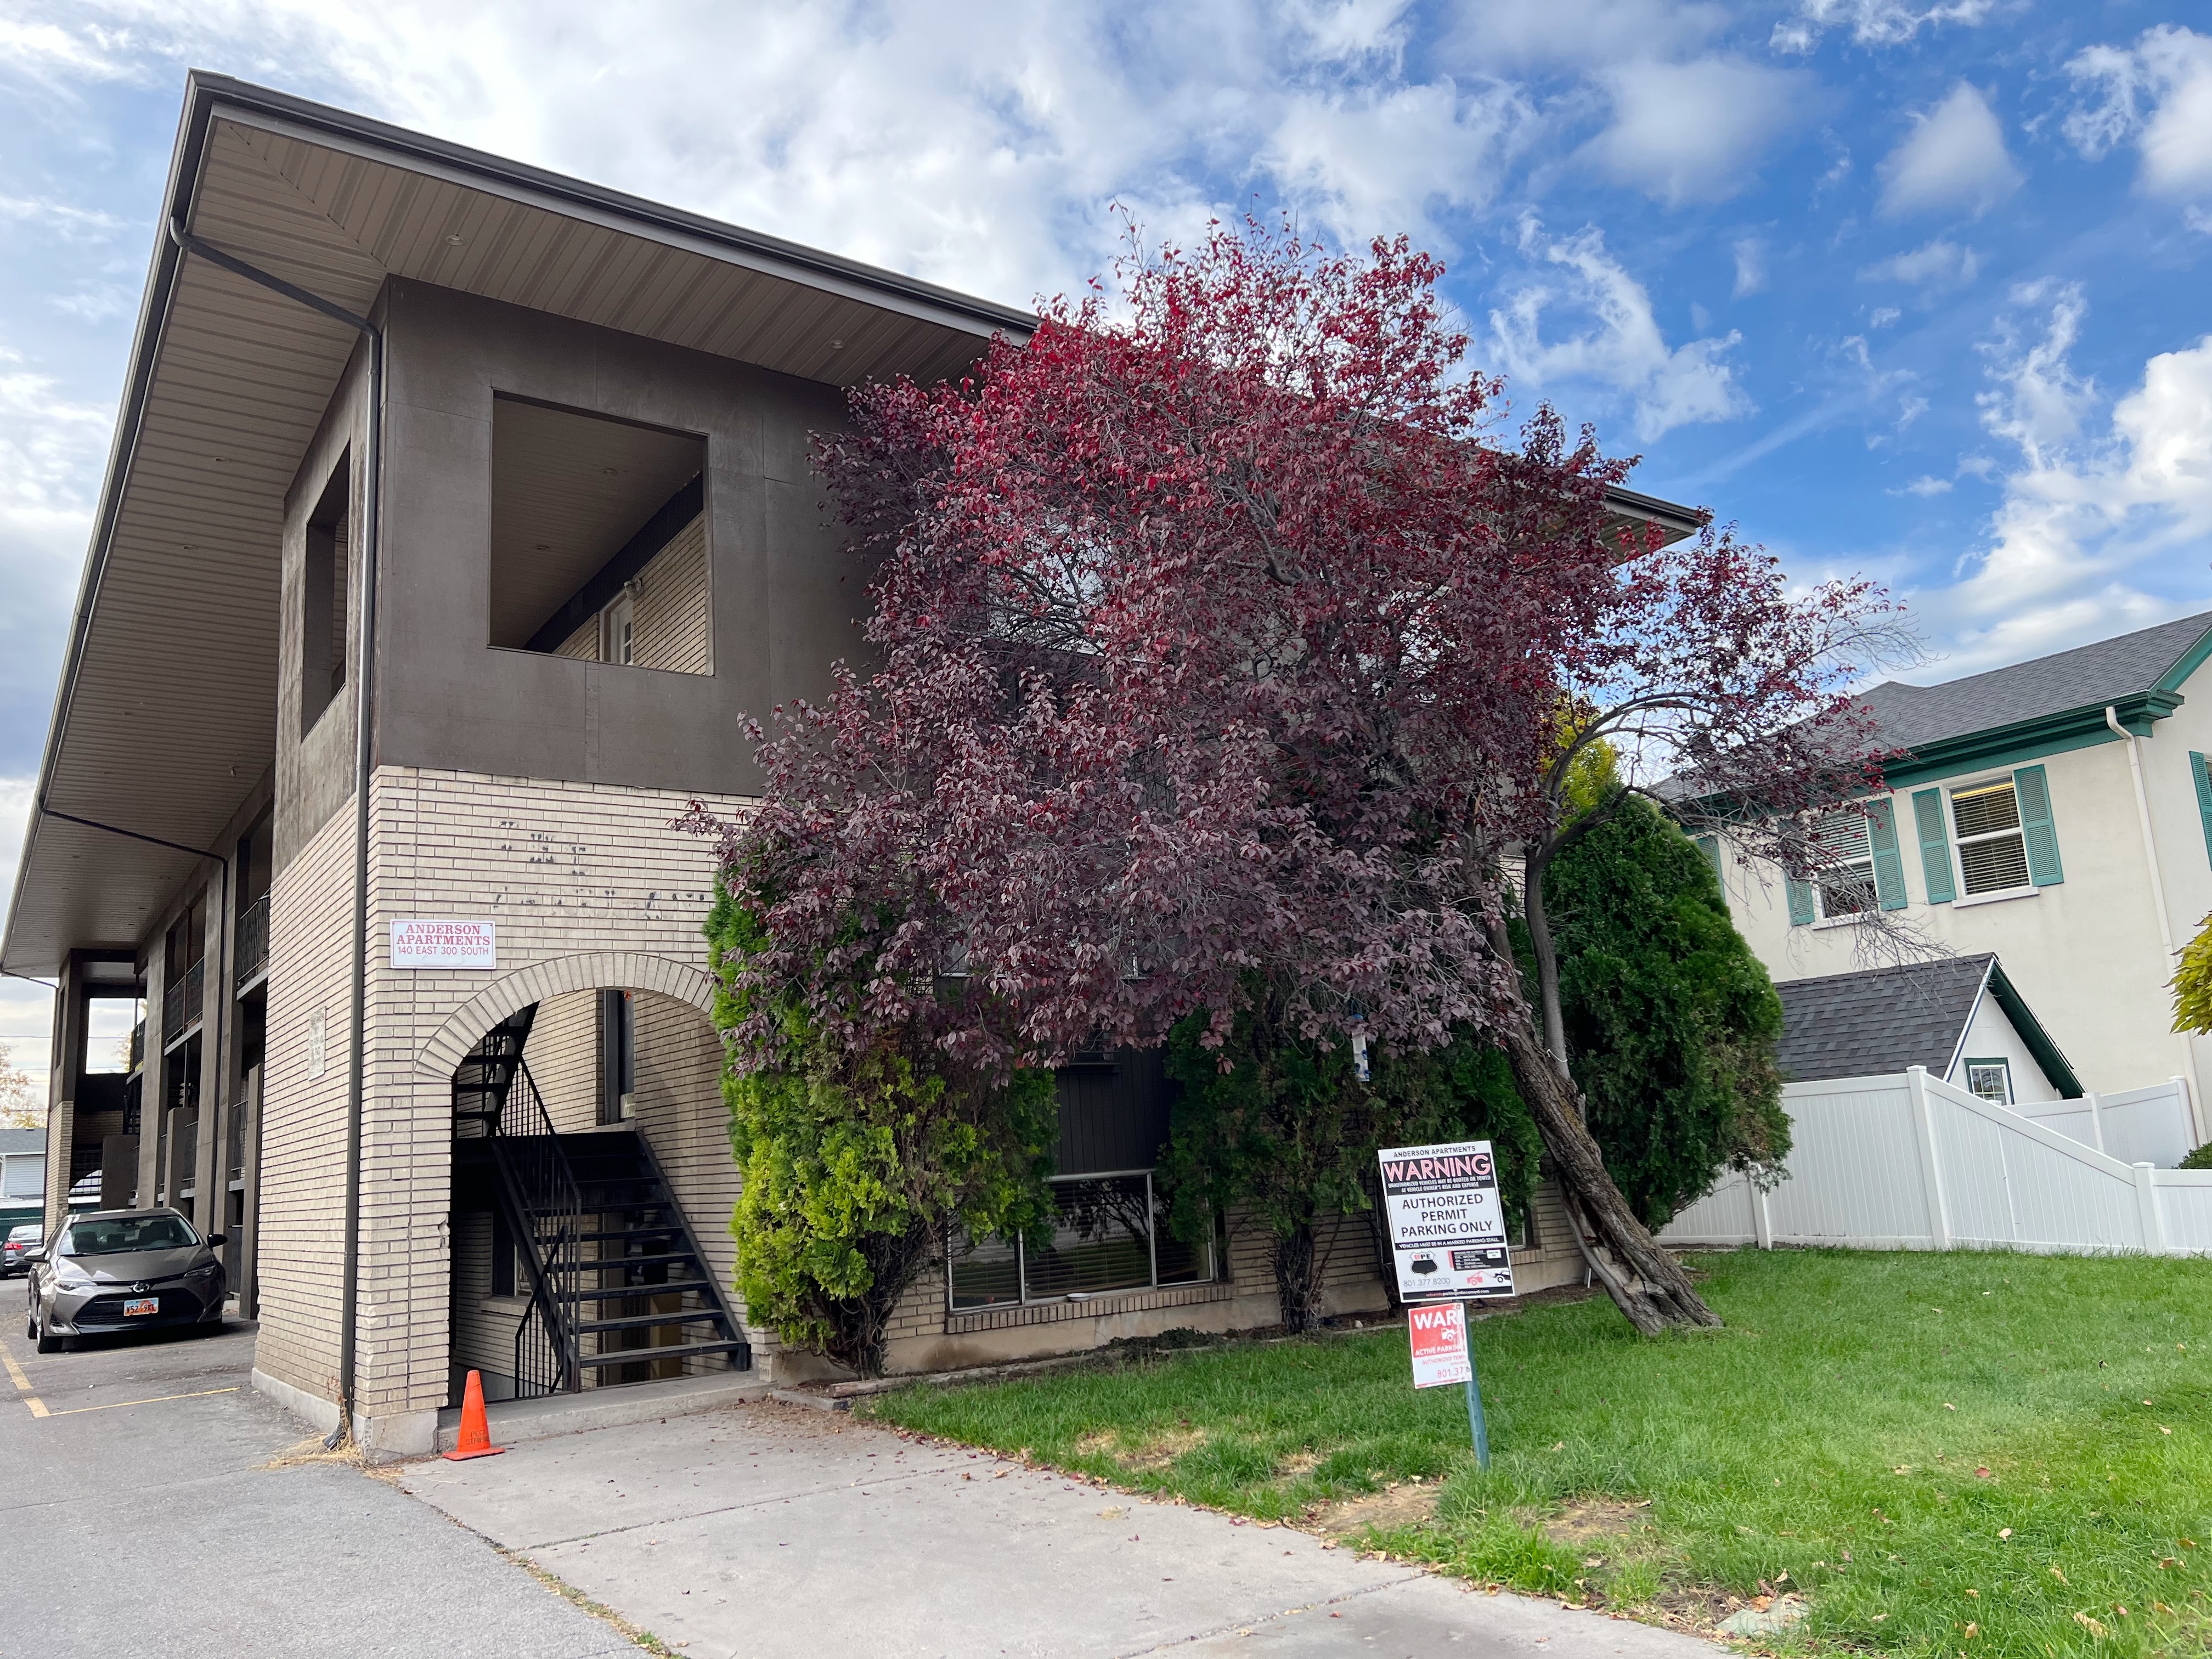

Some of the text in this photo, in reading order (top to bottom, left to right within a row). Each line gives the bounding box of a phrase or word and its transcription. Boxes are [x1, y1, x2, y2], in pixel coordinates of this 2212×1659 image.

[405, 924, 481, 935] ANDERSON
[396, 935, 490, 945] APARTMENTS
[398, 946, 488, 955] 140 EAST 300 SOUTH
[1394, 1146, 1476, 1158] ANDERSON APARTMENTS
[1384, 1154, 1491, 1182] WARNING
[1388, 1181, 1418, 1189] UNAUTHORIZED
[1402, 1194, 1483, 1210] AUTHORIZED
[1421, 1209, 1467, 1222] PERMIT
[1401, 1221, 1492, 1237] PARKING ONLY
[1403, 1277, 1450, 1287] 801.377.8200
[1415, 1344, 1462, 1356] ACTIVE PARKIN
[1422, 1357, 1452, 1365] AUTHORIZED
